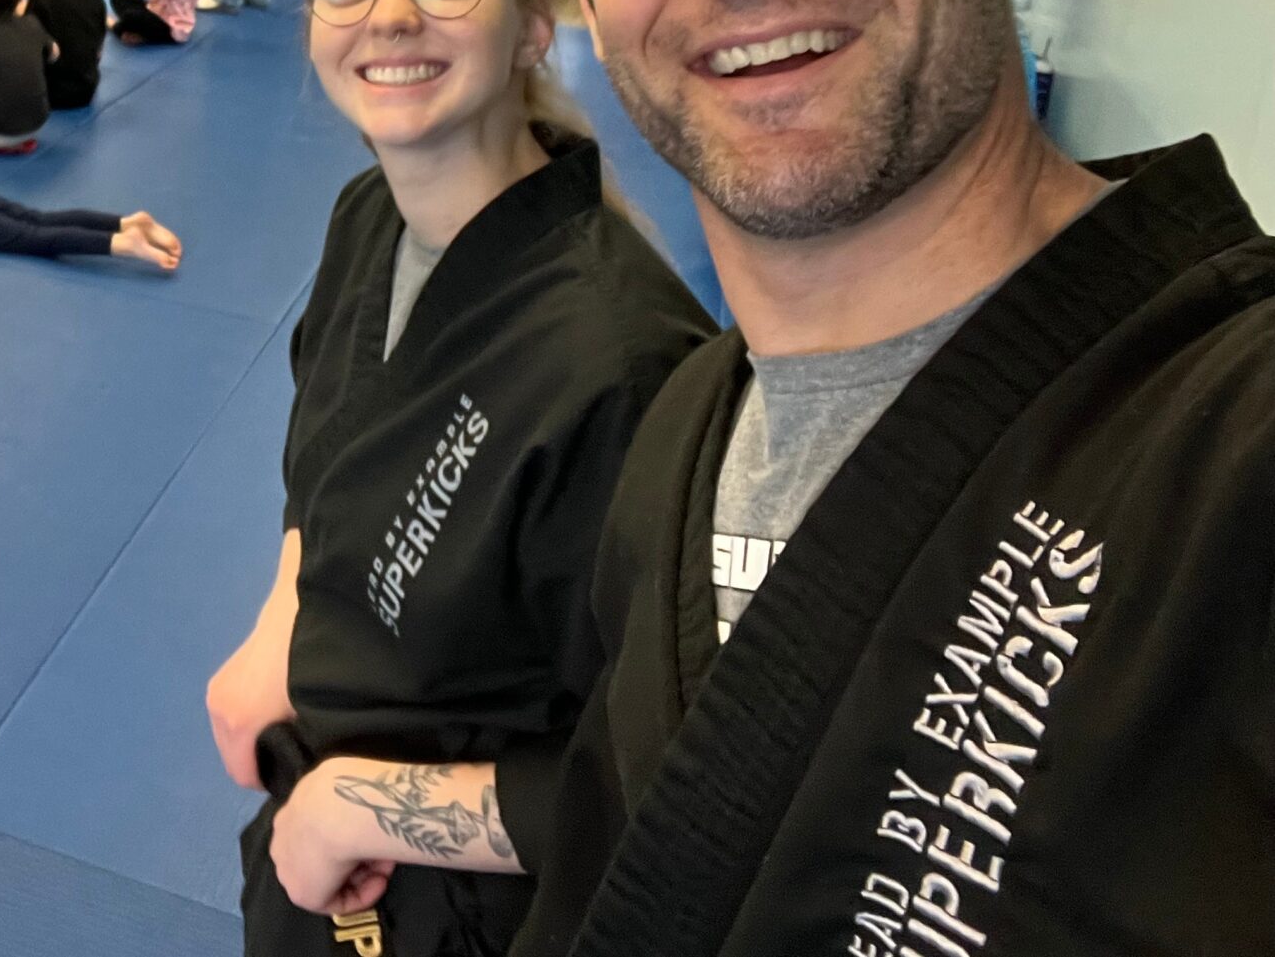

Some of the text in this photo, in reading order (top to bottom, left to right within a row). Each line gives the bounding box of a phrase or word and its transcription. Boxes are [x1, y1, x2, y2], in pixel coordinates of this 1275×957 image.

[378, 410, 489, 638] SUPERKICKS
[876, 768, 941, 853] BY
[913, 500, 1065, 750] EXAMPLE
